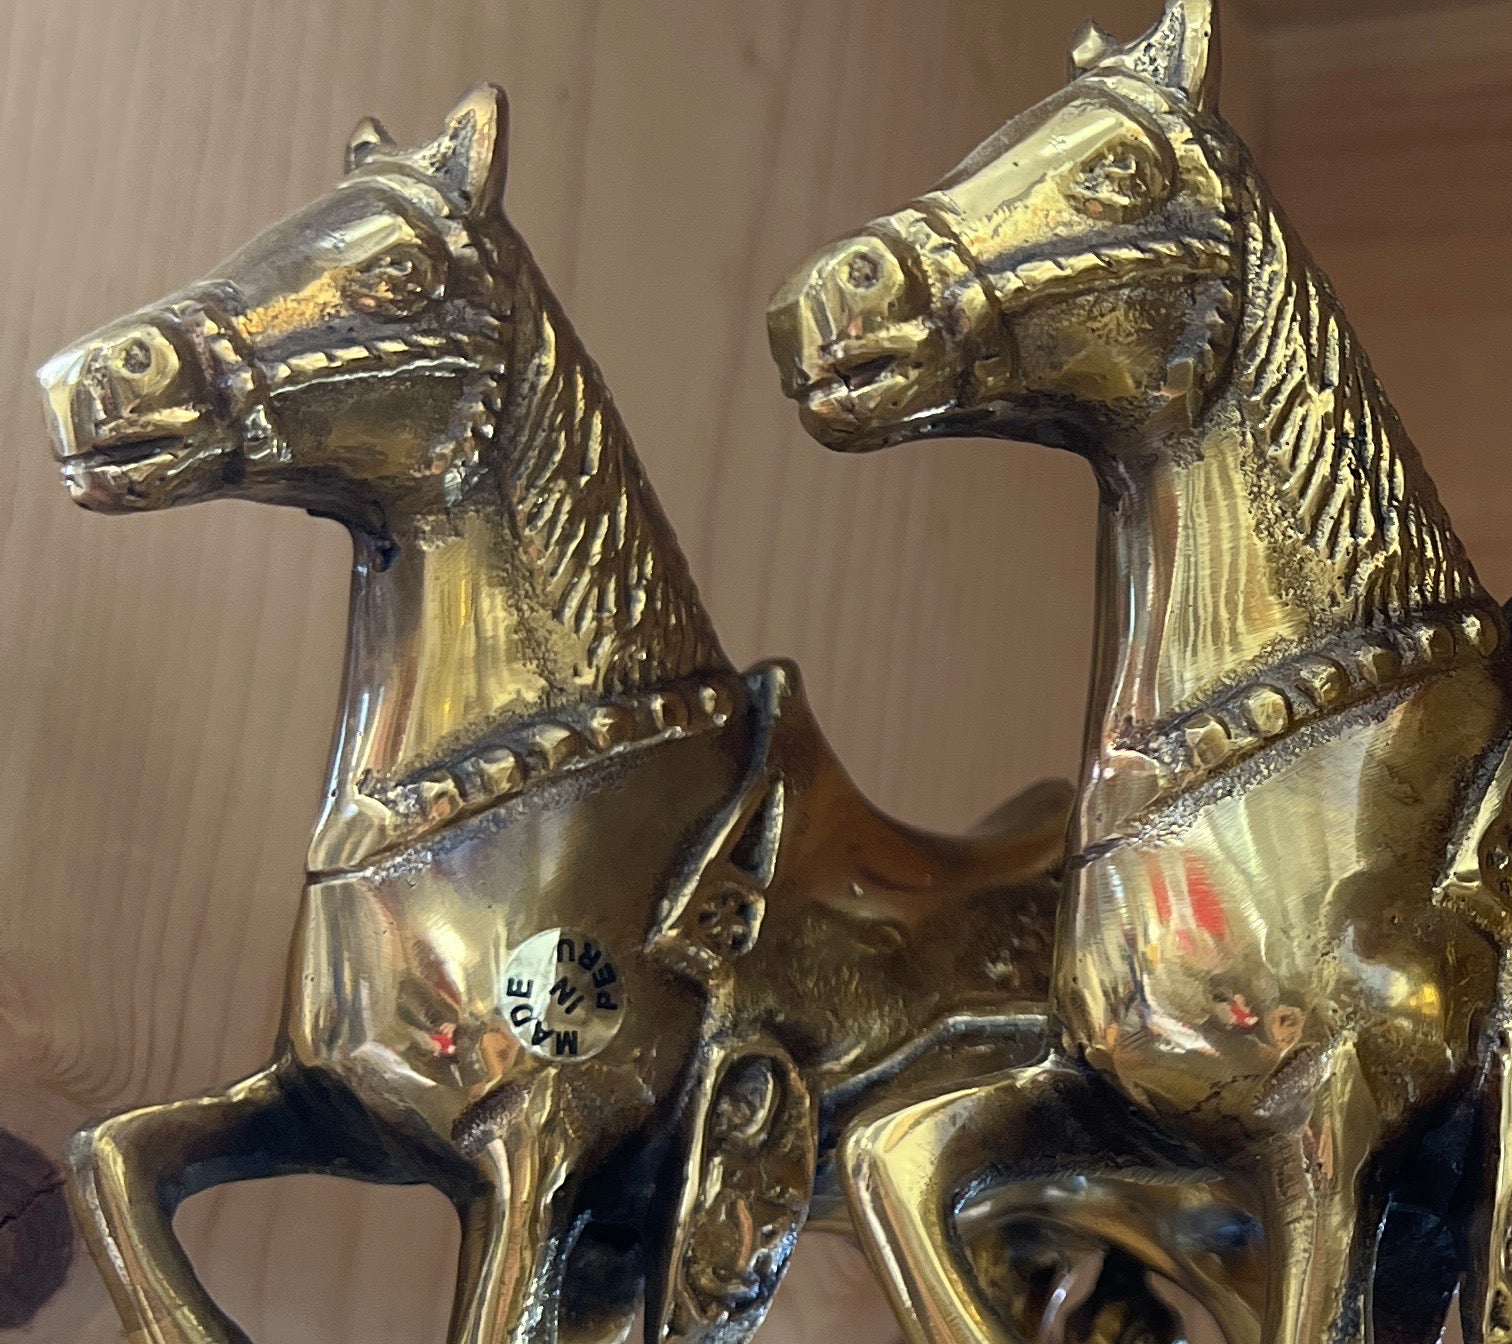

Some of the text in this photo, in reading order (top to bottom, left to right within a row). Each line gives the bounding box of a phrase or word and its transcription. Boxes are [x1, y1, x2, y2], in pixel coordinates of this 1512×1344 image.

[506, 938, 617, 1055] MADE IN PERU
